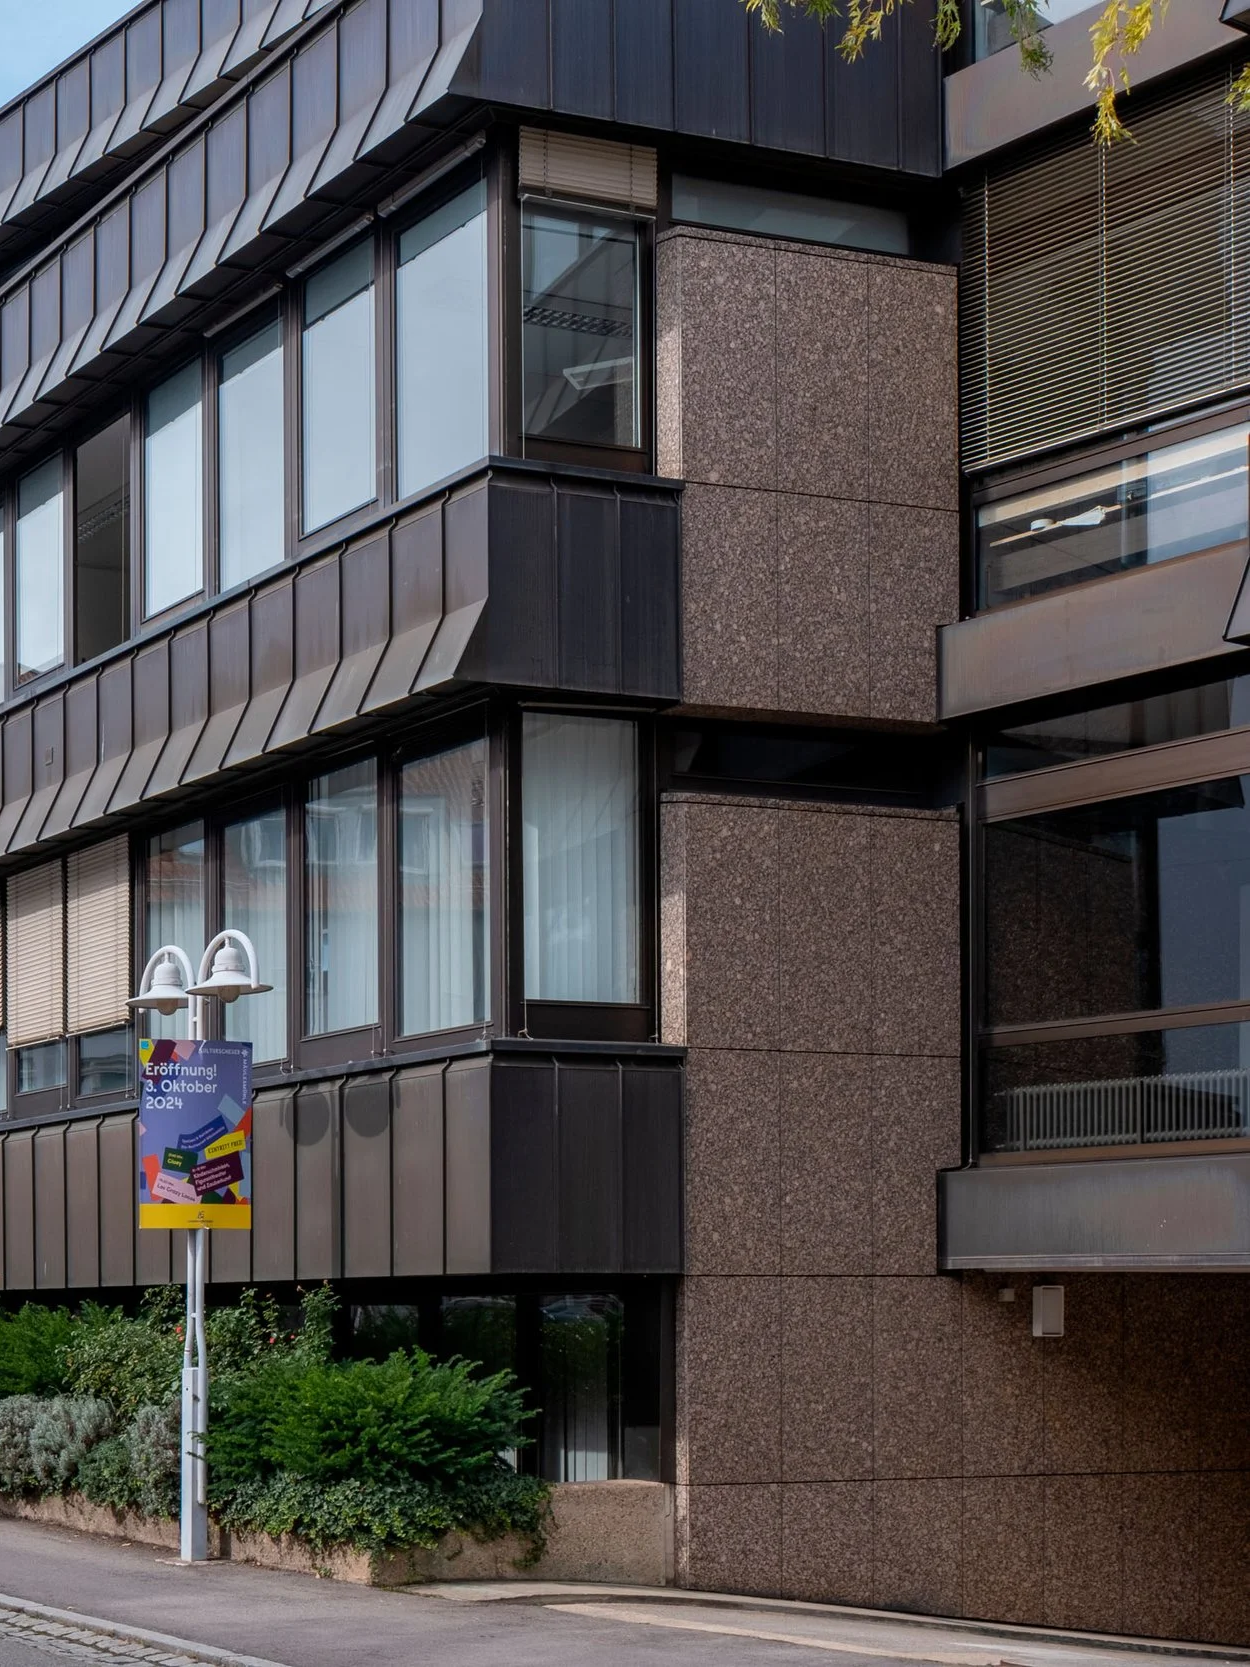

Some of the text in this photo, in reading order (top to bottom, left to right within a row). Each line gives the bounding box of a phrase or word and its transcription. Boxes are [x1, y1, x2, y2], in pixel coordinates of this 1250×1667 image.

[146, 1062, 217, 1080] Eröffnung!
[145, 1079, 218, 1093] 3. Oktober
[146, 1096, 183, 1109] 2024
